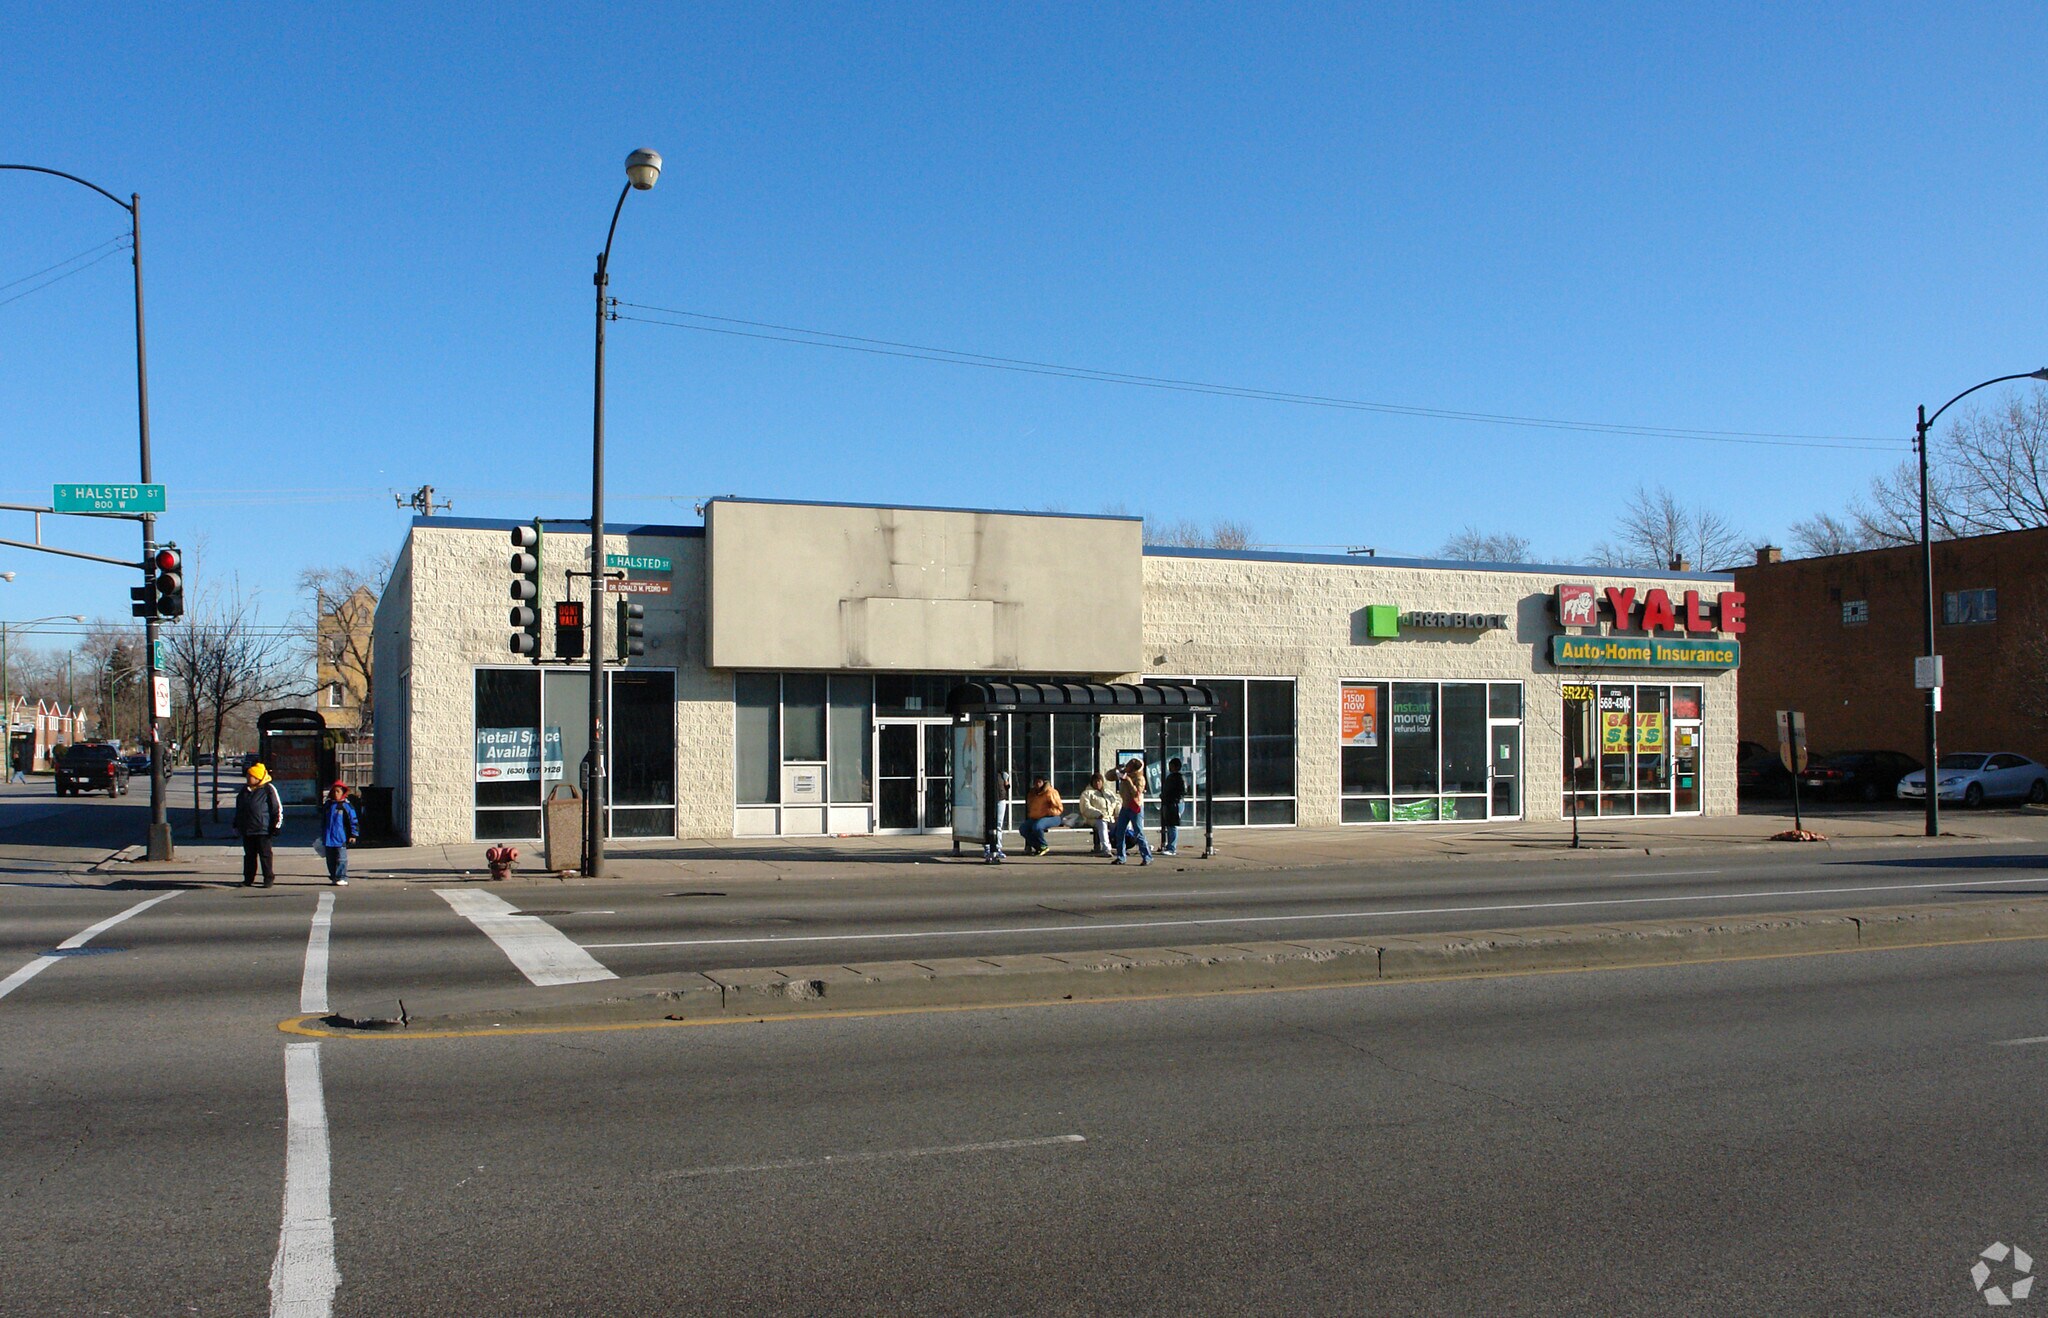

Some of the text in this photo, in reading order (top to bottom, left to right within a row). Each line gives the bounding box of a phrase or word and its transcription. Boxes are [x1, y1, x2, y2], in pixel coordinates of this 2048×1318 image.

[61, 487, 159, 499] S HALSTED ST
[94, 501, 126, 509] 800 W
[617, 556, 661, 569] HALSTED
[618, 584, 637, 592] DONALD
[1604, 587, 1746, 633] YALE
[559, 615, 578, 626] WALK
[1413, 611, 1508, 629] H&R BLOCK
[1562, 642, 1733, 662] Auto-Home Insurance
[1343, 702, 1365, 710] now
[1394, 701, 1431, 713] instant
[1393, 714, 1431, 727] money
[1607, 713, 1658, 728] SAVE
[1395, 725, 1431, 733] refund loan
[477, 731, 518, 744] Retail
